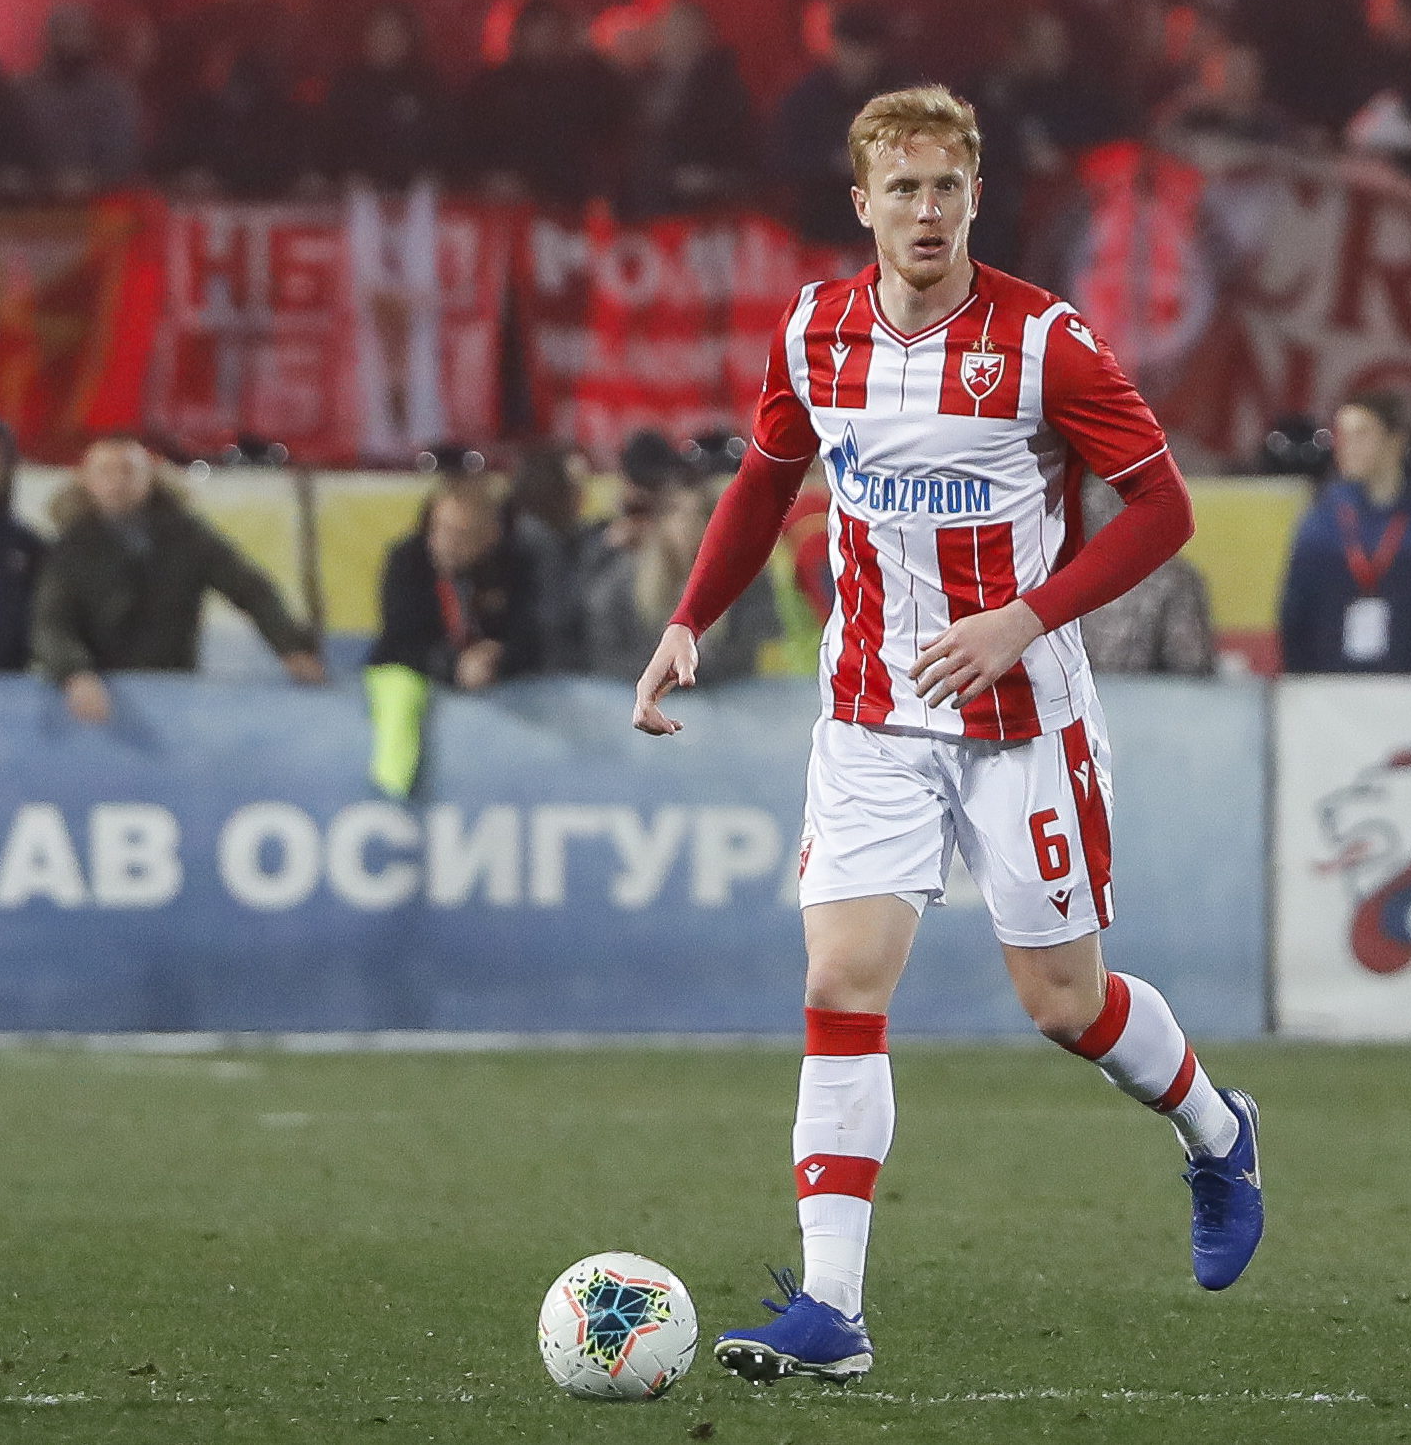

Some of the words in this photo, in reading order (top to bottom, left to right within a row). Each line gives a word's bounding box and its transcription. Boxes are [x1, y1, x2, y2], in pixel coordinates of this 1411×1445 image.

[869, 476, 991, 514] GAZPROM
[216, 801, 804, 910] ОСИГУР
[1028, 808, 1071, 882] 6
